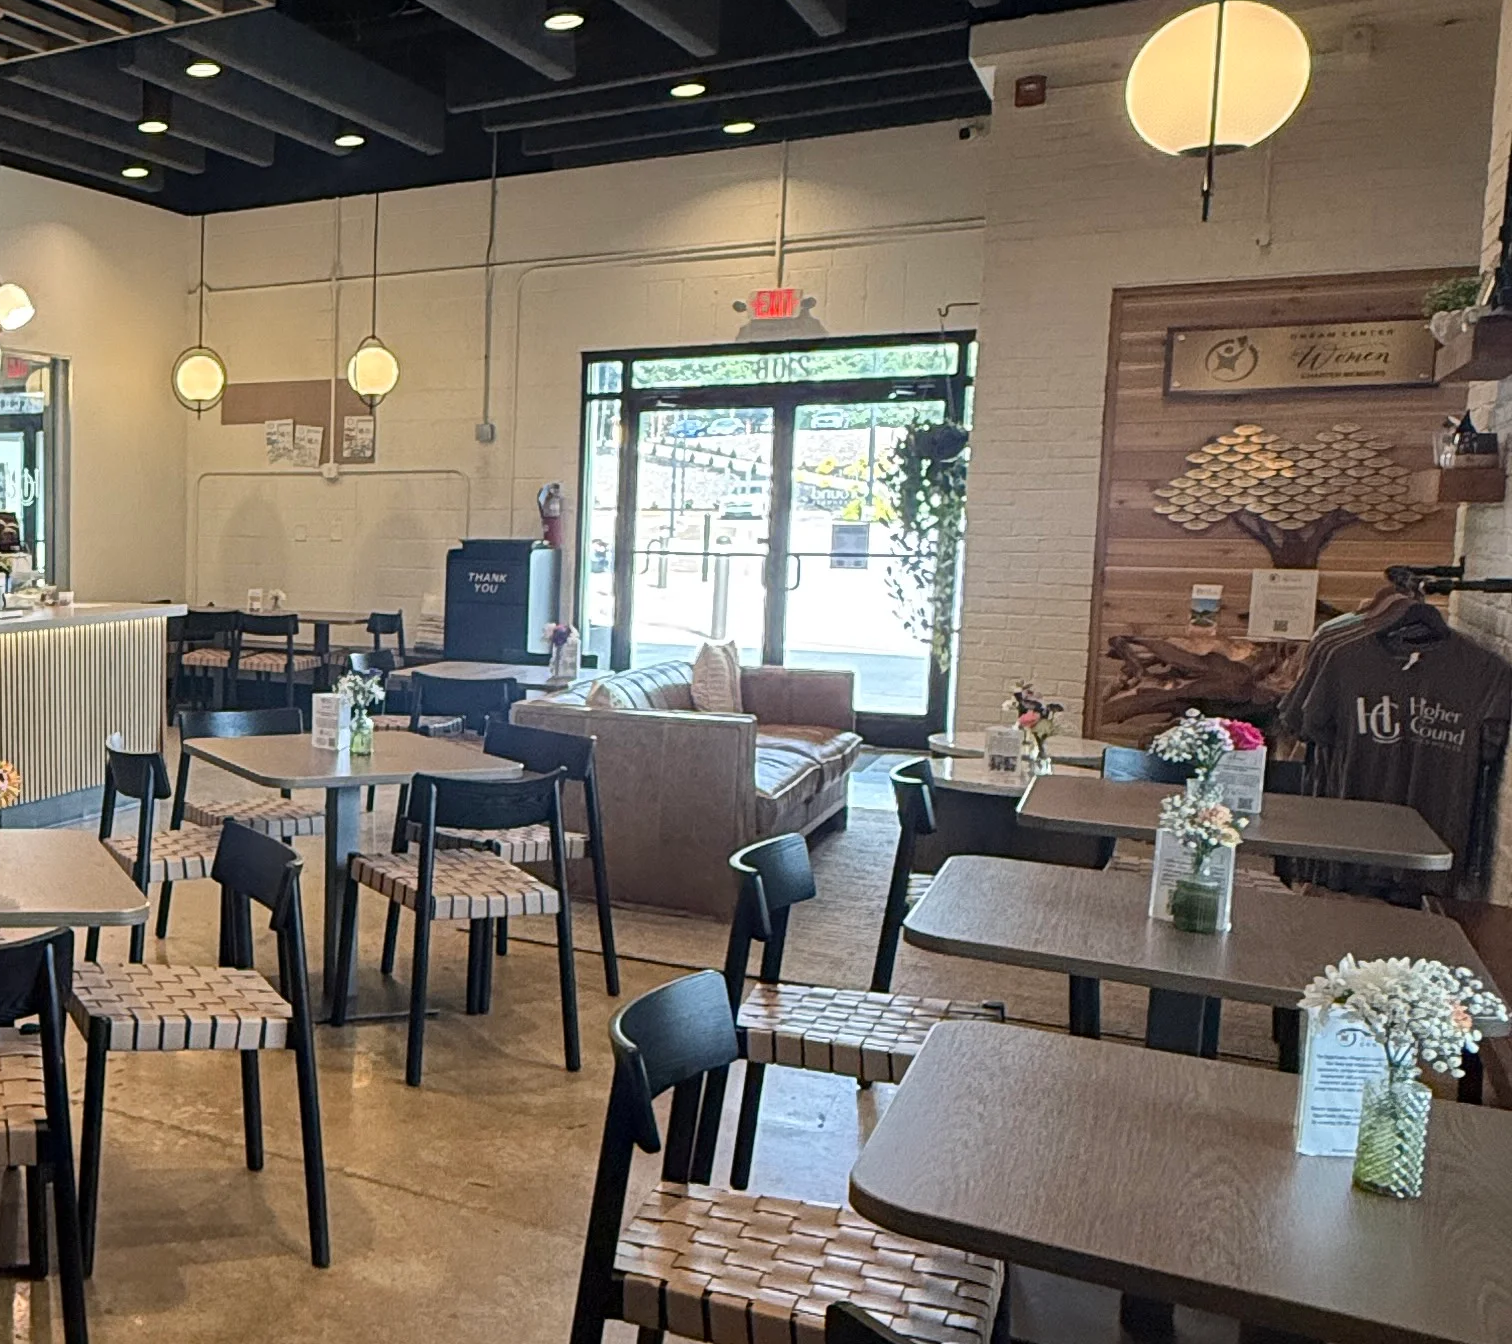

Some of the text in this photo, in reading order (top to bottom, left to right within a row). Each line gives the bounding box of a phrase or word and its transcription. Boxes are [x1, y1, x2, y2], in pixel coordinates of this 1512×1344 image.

[469, 571, 507, 582] THANK
[474, 583, 499, 594] YOU
[1409, 696, 1462, 724] Higher
